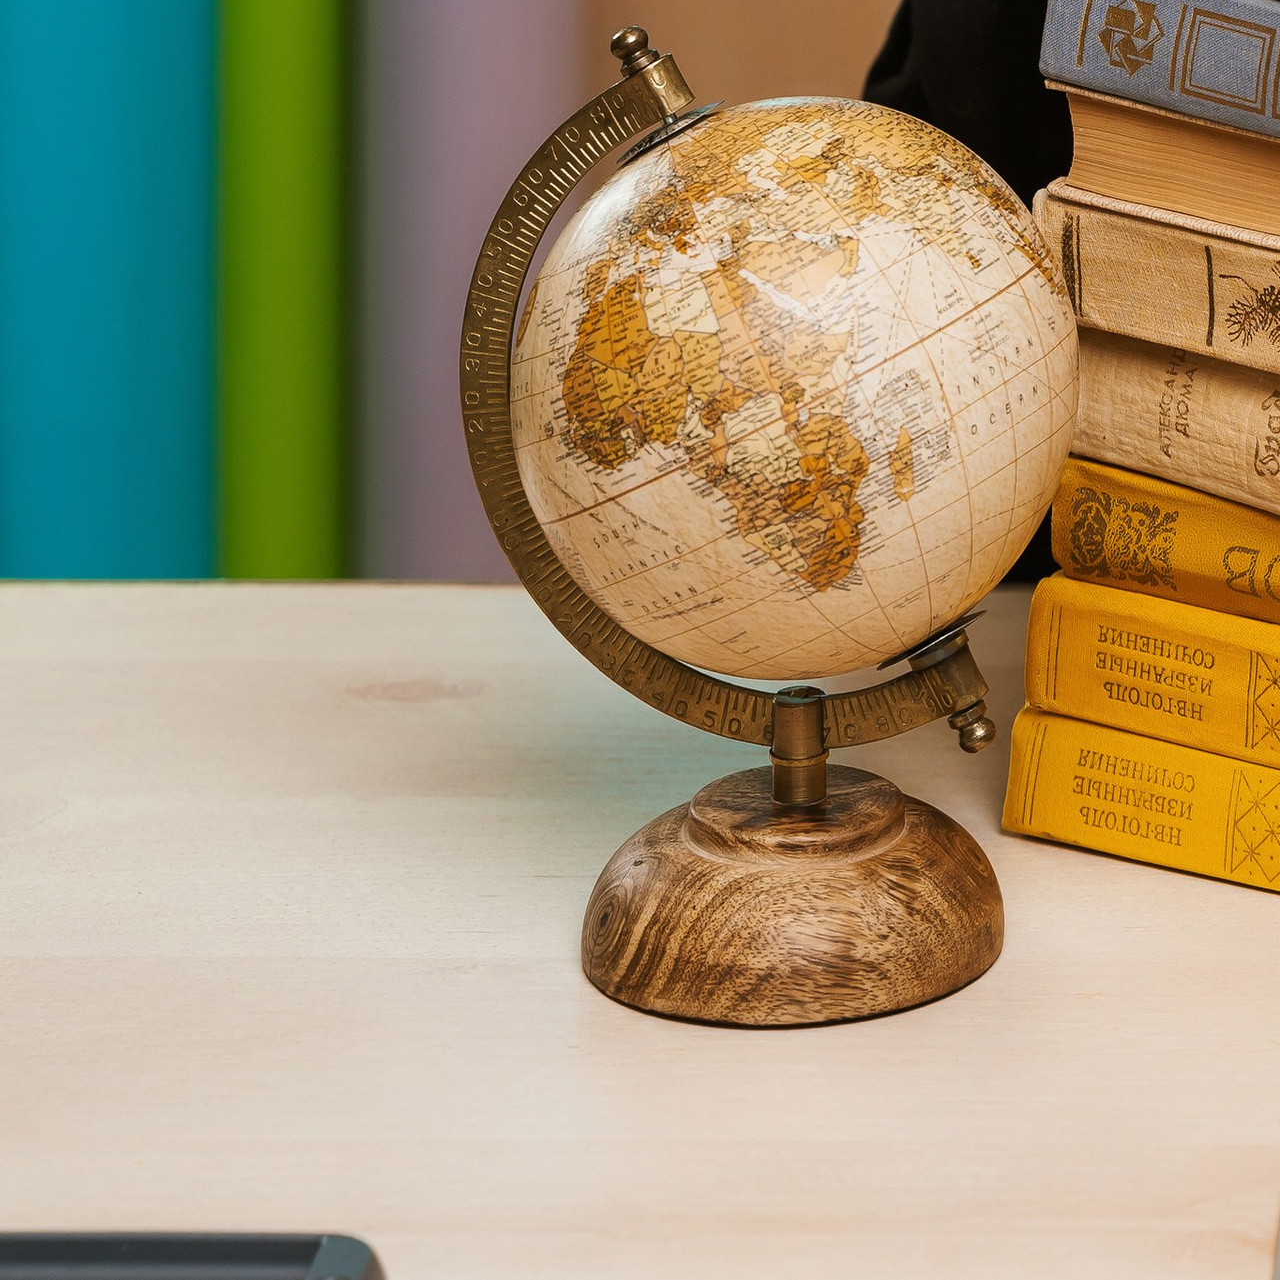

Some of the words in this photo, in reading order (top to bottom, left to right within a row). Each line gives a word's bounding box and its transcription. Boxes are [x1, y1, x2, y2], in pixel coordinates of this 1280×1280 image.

[956, 338, 1034, 395] INDIAN
[970, 385, 1039, 436] OCEAN
[1158, 349, 1187, 459] АЛЕКСАНД
[1175, 367, 1198, 439] ДЮМА
[593, 520, 642, 549] SOUTH
[602, 544, 685, 583] ATLANTIC
[641, 585, 698, 614] OCEAN
[1097, 625, 1215, 669] СОЧИНЕНИЯ
[1095, 651, 1212, 696] ИЗБРАННЫЕ
[1077, 748, 1196, 793] СОЧИНЕНИЯ
[1072, 775, 1194, 821] ИЗБРАННЫЕ
